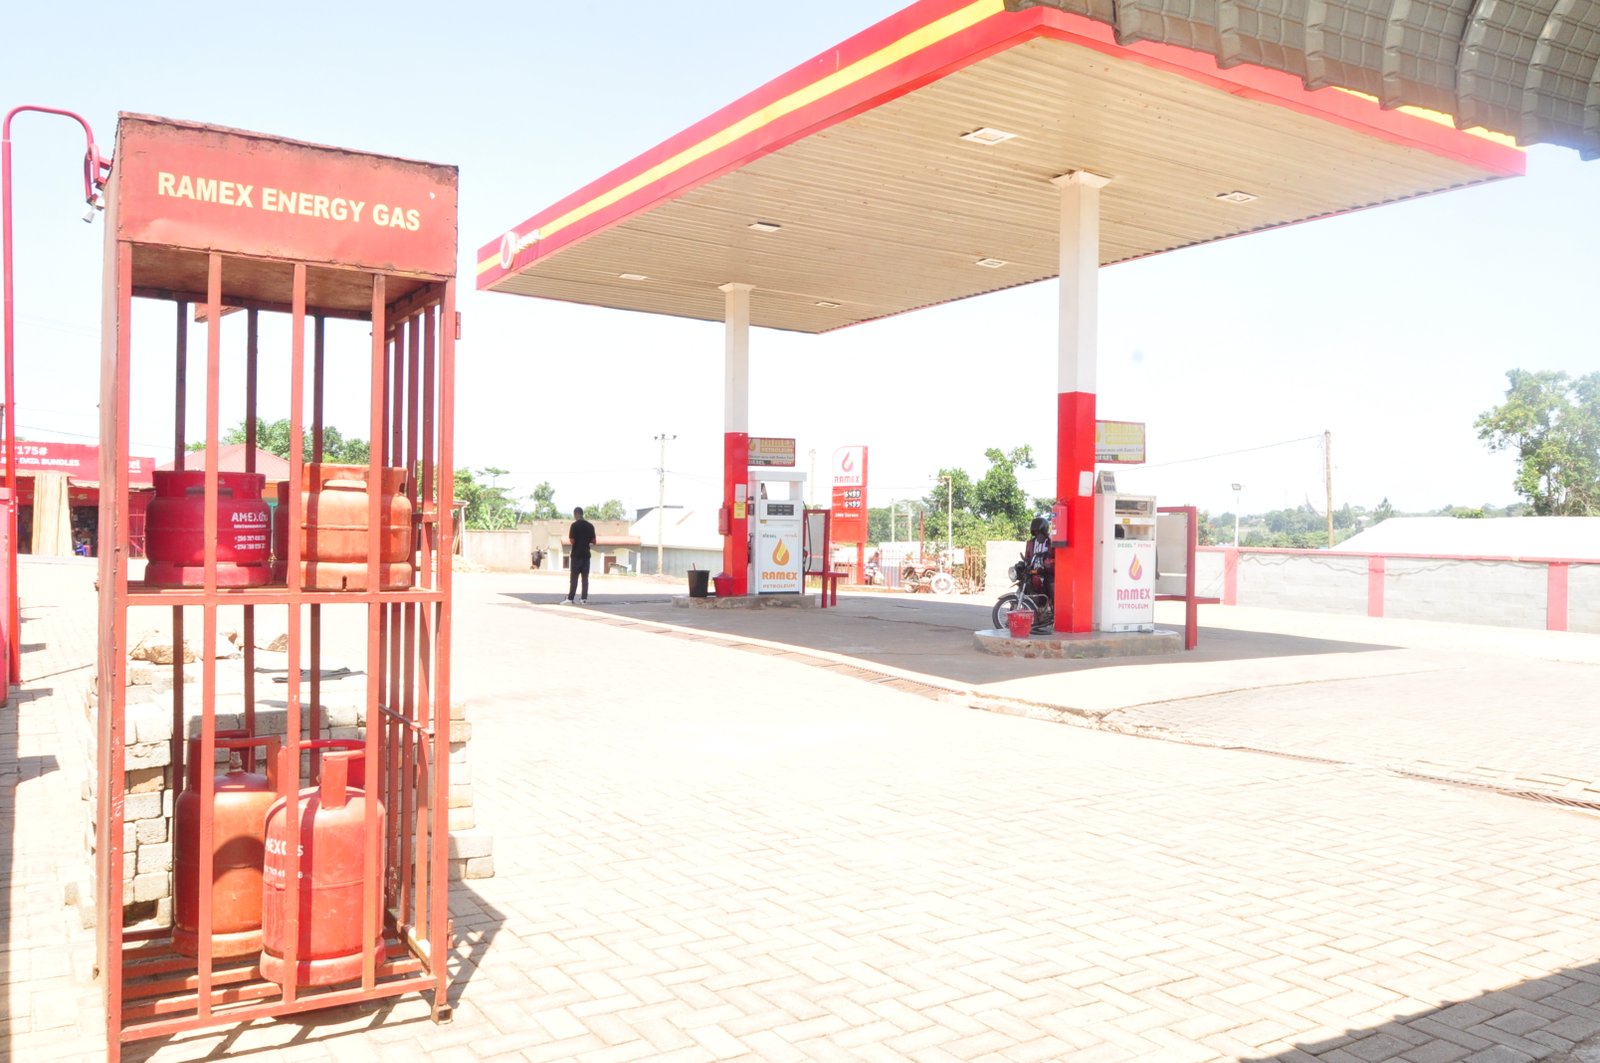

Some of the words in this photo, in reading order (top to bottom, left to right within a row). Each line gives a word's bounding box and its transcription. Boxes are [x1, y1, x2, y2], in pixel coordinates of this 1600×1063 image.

[157, 171, 254, 208] RAMEX
[261, 187, 366, 222] ENERGY
[372, 203, 421, 232] GAS
[20, 457, 40, 465] DATA
[41, 458, 80, 467] BUNDLES
[762, 571, 798, 580] RAMEX
[1117, 588, 1151, 600] RAMEX
